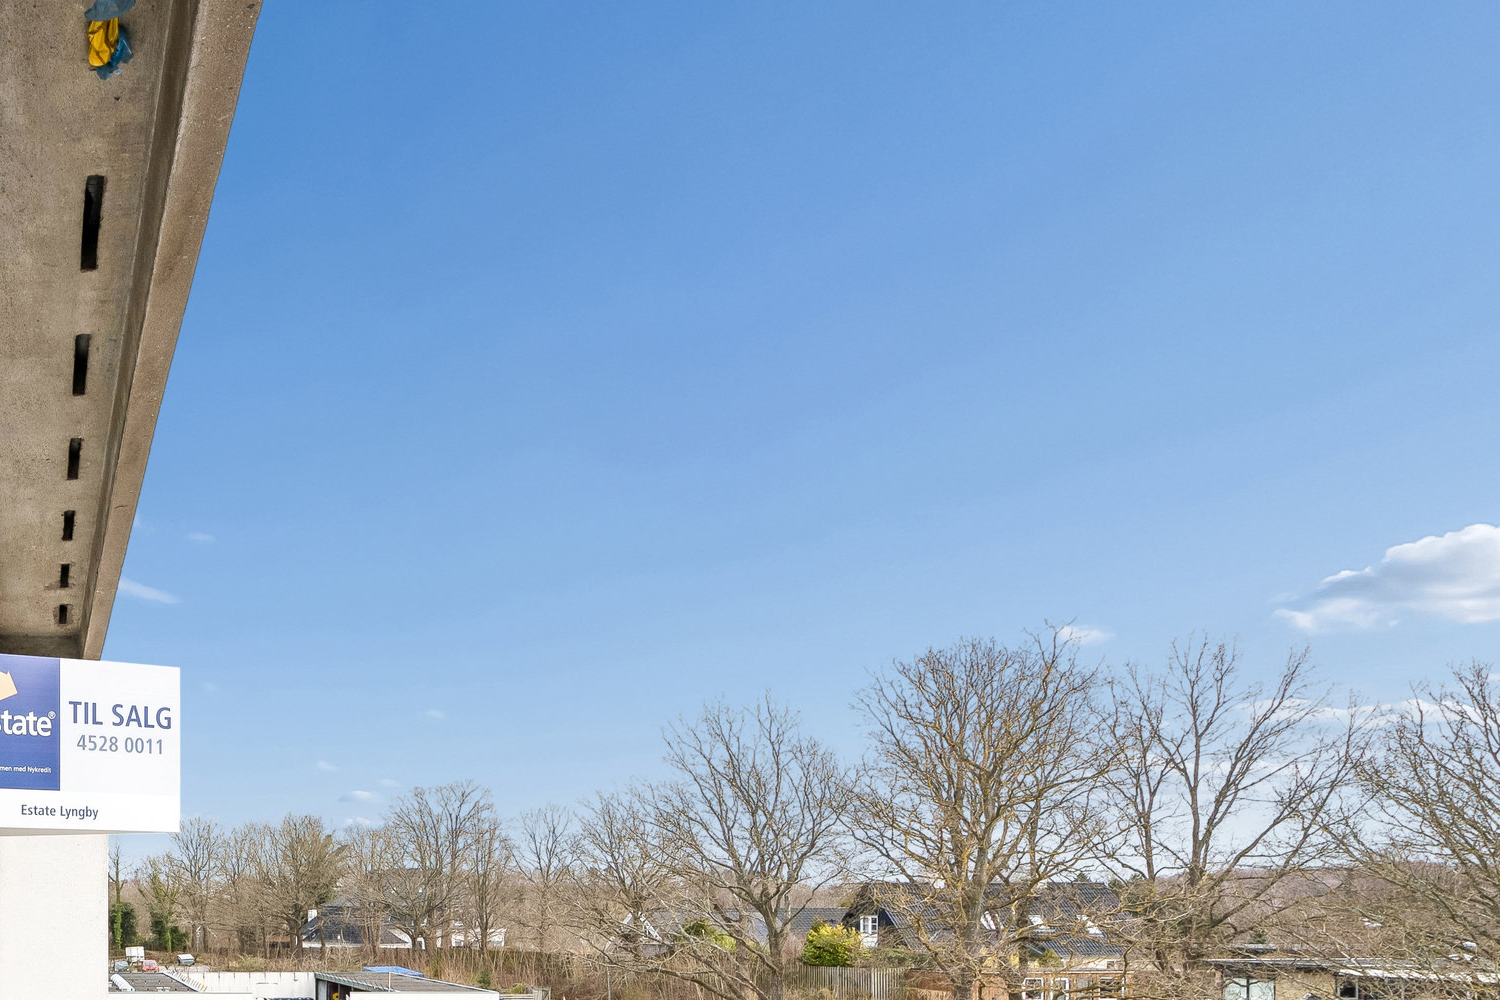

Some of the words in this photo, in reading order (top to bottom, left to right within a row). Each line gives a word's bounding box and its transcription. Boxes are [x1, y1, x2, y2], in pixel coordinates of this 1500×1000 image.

[68, 700, 103, 726] TIL
[111, 703, 172, 730] SALG
[77, 734, 119, 753] 4528
[124, 736, 163, 755] 0011
[21, 804, 56, 816] Estate
[60, 805, 99, 821] Lyngby
